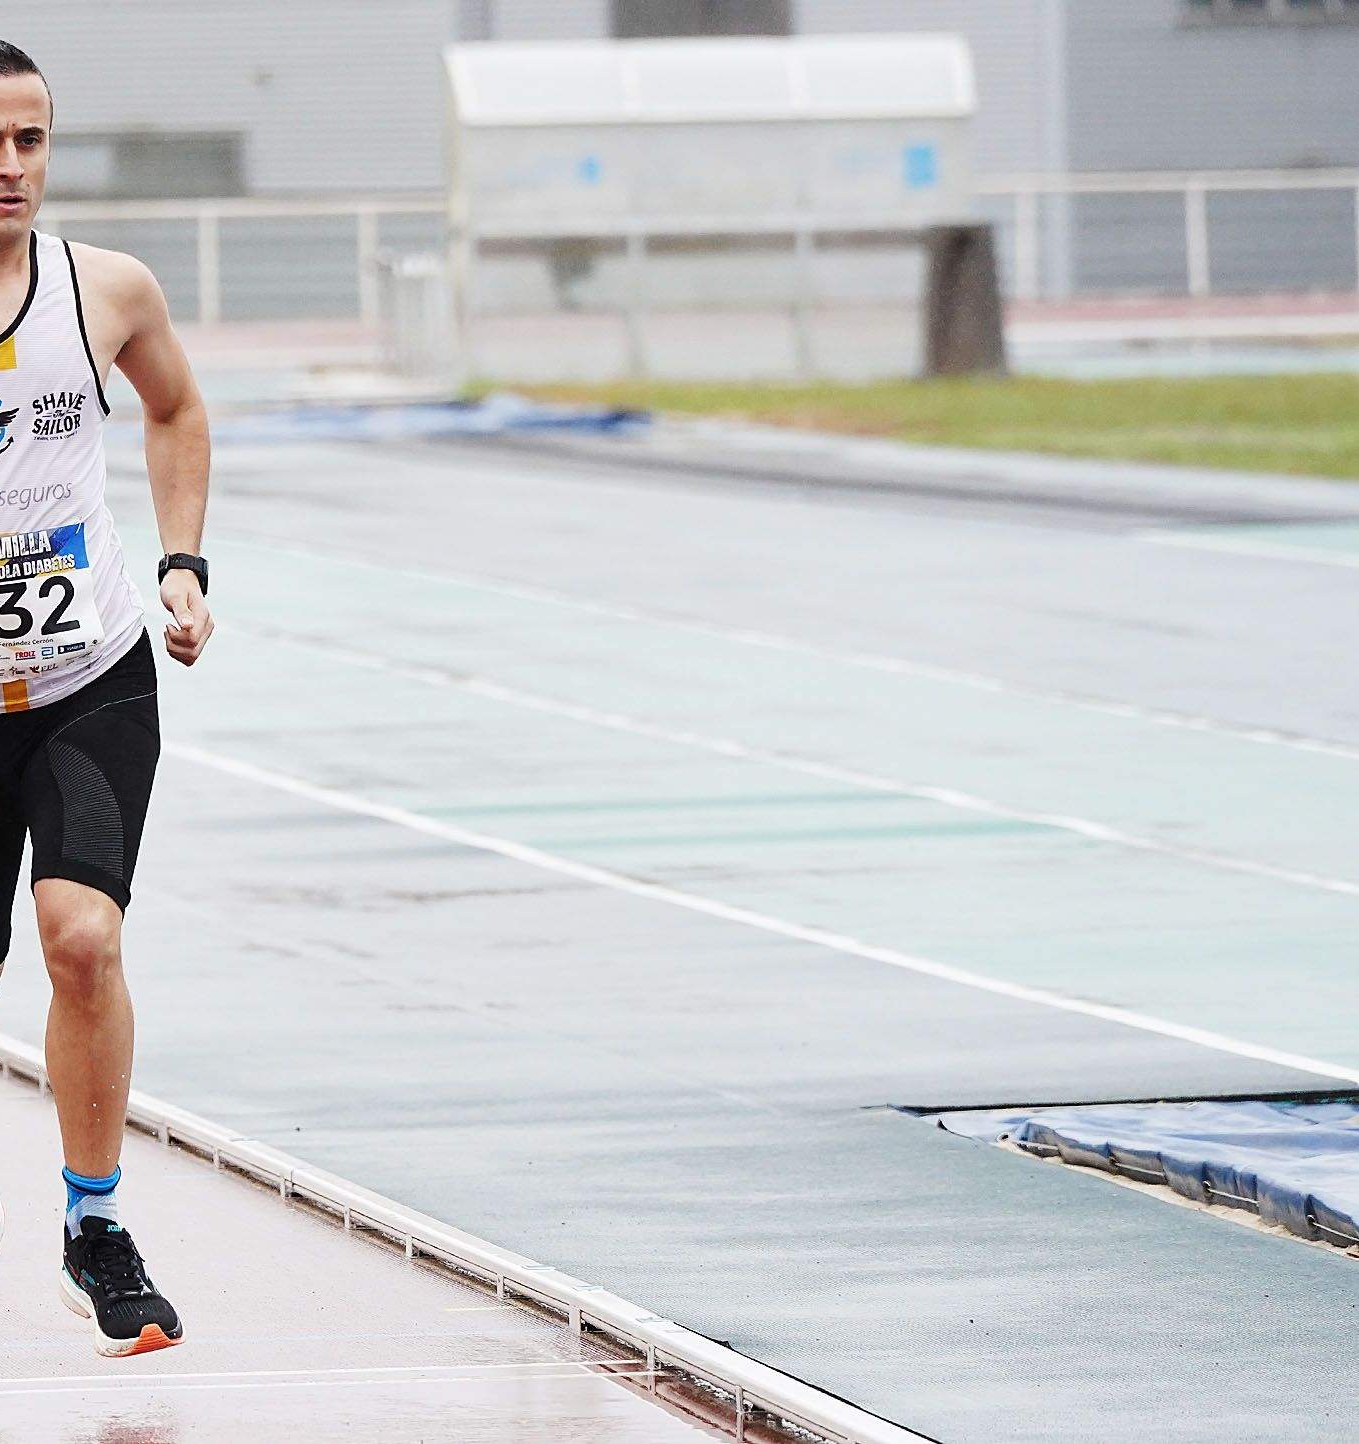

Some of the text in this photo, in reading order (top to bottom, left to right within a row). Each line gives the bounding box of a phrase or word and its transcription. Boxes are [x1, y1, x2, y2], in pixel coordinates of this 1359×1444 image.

[32, 391, 87, 415] SHAVE
[31, 413, 81, 436] SAILOR
[23, 553, 75, 576] DIABETES
